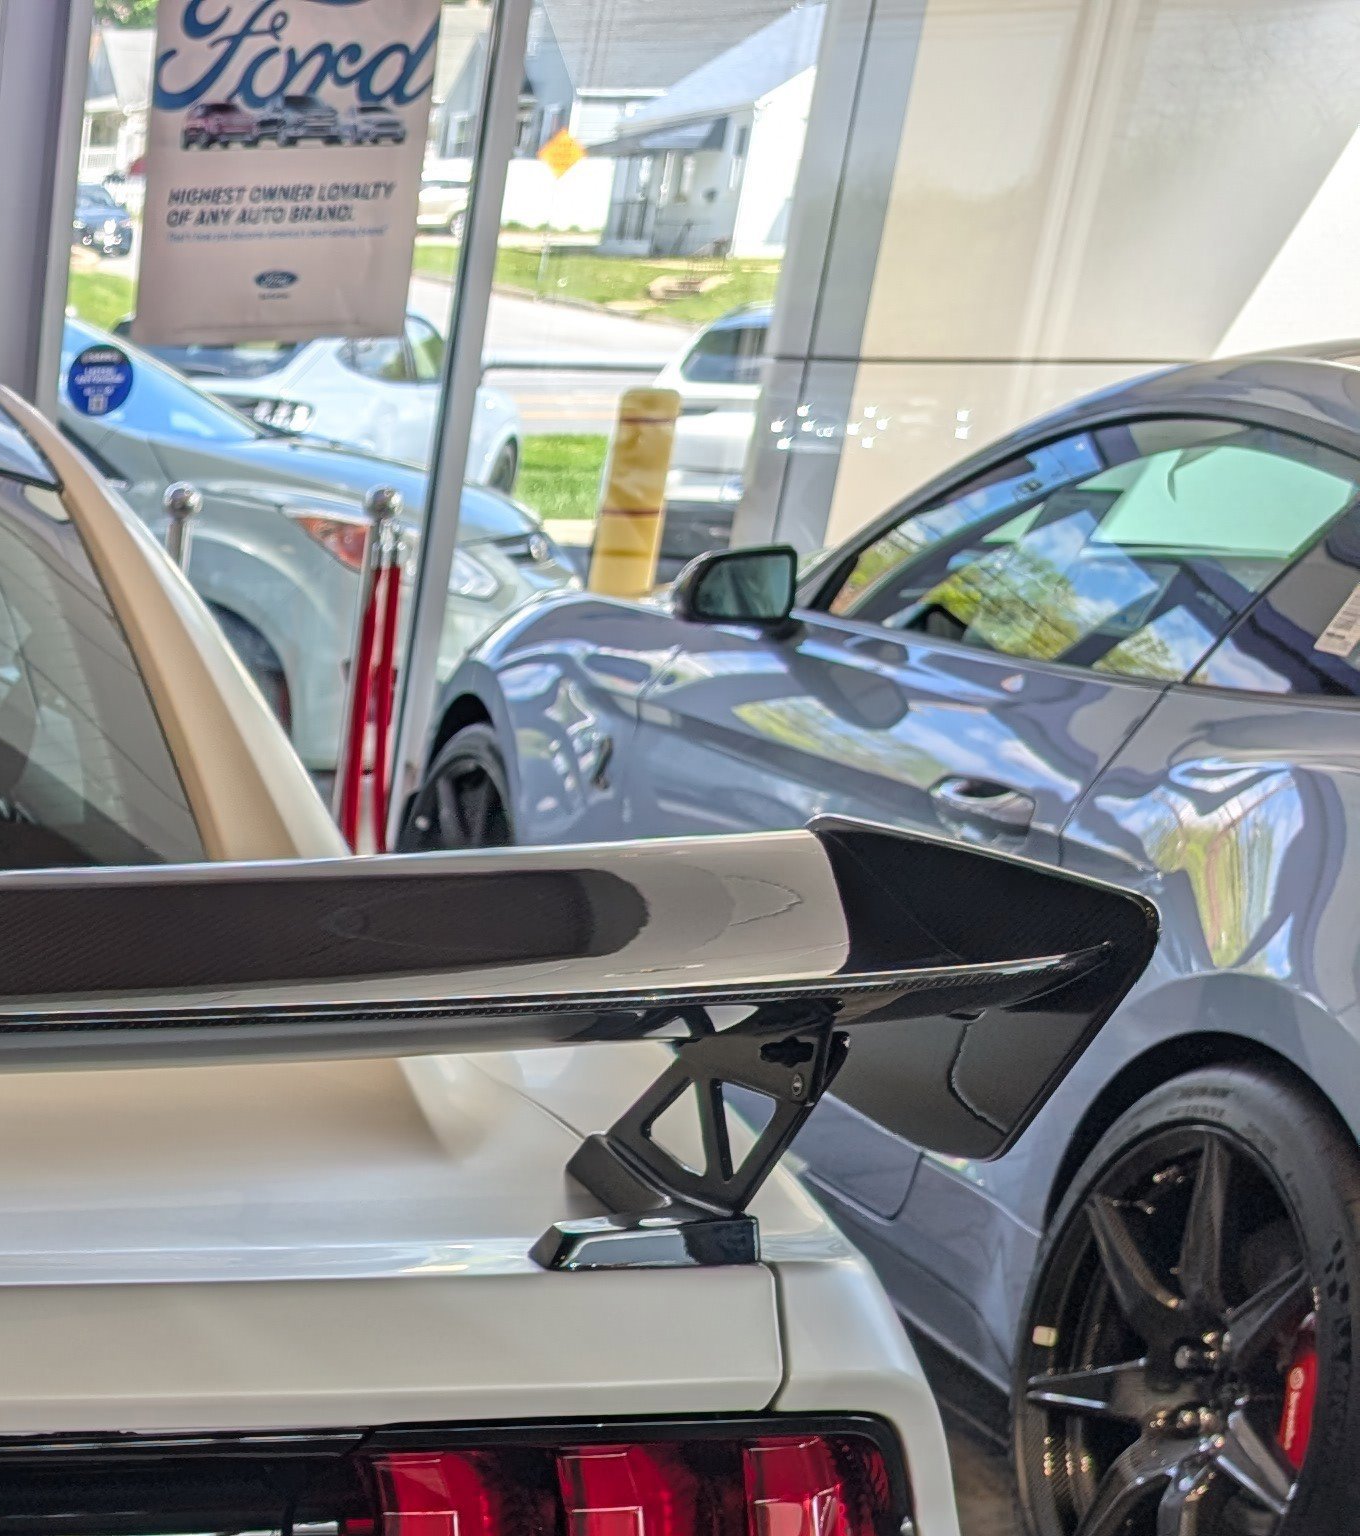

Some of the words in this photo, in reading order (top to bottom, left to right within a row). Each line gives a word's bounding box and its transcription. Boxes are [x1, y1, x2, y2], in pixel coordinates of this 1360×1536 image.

[154, 0, 441, 111] Ford
[168, 186, 246, 206] HIGHEST
[248, 183, 314, 204] OWNER
[317, 180, 397, 201] LOYALTY
[166, 208, 192, 228] OF
[194, 207, 234, 226] ANY
[236, 206, 286, 225] AUTO
